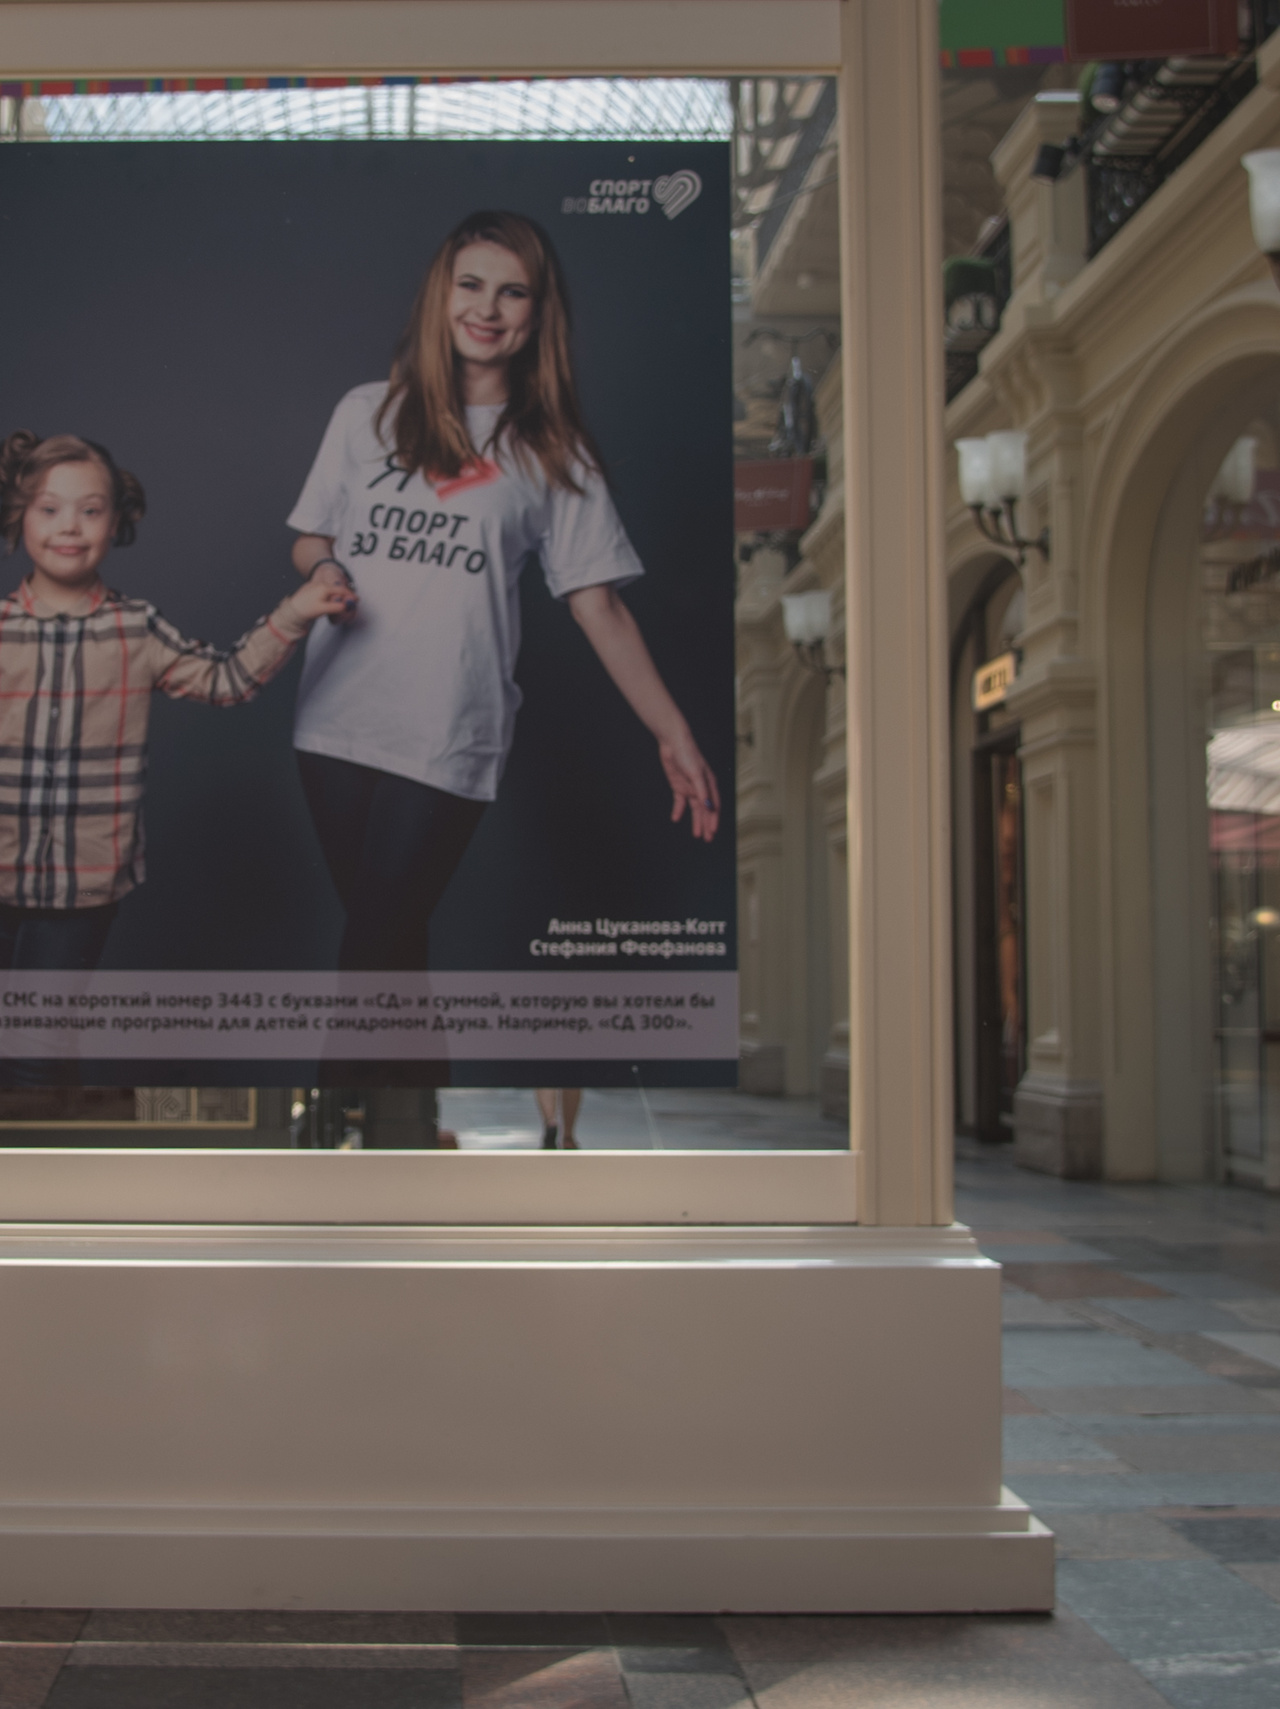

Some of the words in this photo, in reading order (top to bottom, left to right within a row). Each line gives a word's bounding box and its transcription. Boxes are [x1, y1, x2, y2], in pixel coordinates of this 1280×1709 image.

[589, 179, 653, 196] СПОРТ
[370, 503, 469, 540] СПОРТ
[388, 535, 487, 574] БЛАГО
[548, 918, 593, 935] Анна
[595, 918, 727, 938] Цуканова-Котт
[529, 939, 618, 959] Стефания
[620, 939, 727, 959] Феофанова
[2, 991, 37, 1008] СМС
[41, 994, 64, 1008] на
[67, 991, 152, 1010] короткий
[155, 994, 214, 1011] номер
[218, 991, 264, 1009] 3443
[267, 995, 277, 1008] с
[280, 992, 359, 1012] буквами
[362, 992, 413, 1010] «СД»
[417, 995, 429, 1008] и
[432, 992, 506, 1011] суммой,
[509, 995, 589, 1012] которую
[592, 995, 619, 1009] вы
[623, 995, 686, 1009] хотели
[688, 992, 716, 1009] бы
[110, 1016, 214, 1033] программы
[217, 1017, 251, 1032] для
[253, 1014, 309, 1032] детей
[312, 1017, 321, 1030] с
[326, 1017, 428, 1033] синдромом
[430, 1014, 493, 1034] Дауна.
[497, 1014, 593, 1034] Например,
[598, 1014, 637, 1032] «СД
[640, 1014, 693, 1031] 300».
